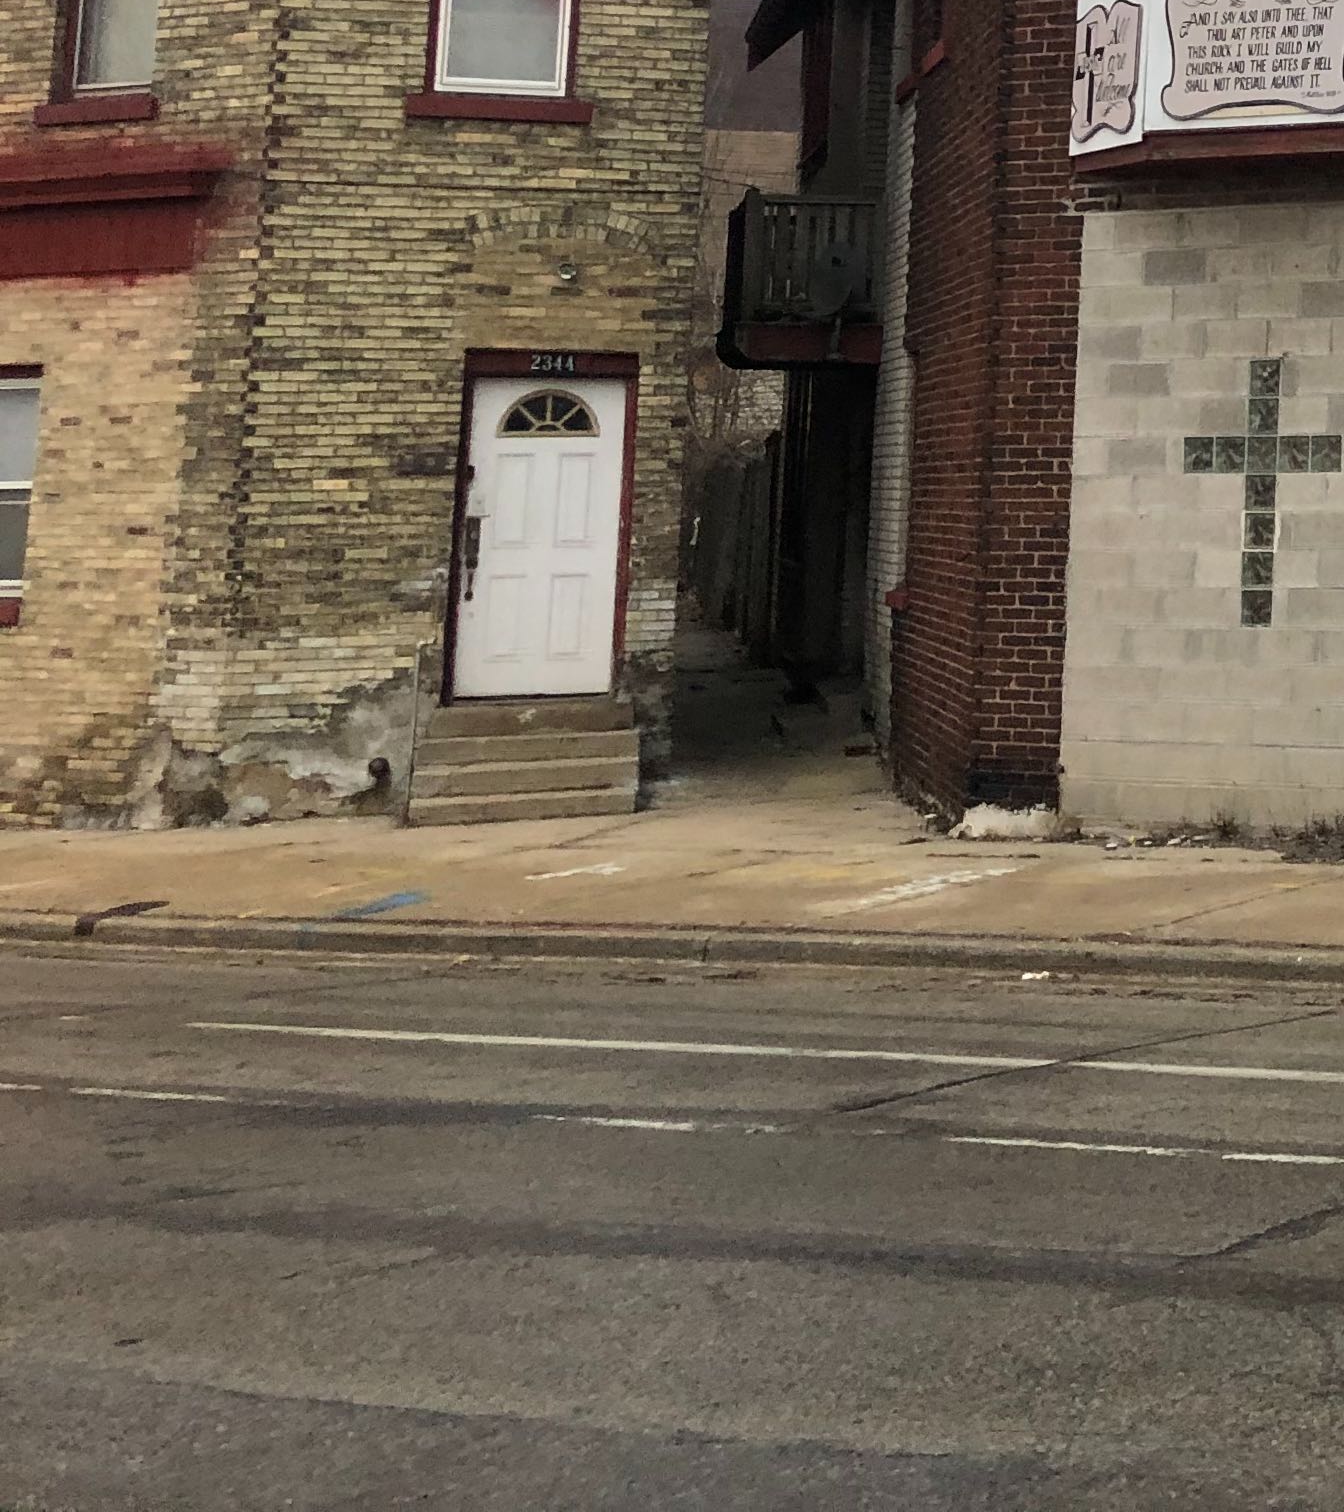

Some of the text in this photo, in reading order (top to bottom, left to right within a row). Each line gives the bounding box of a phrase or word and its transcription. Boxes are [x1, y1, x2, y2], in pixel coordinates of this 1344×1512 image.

[1213, 11, 1218, 26] I
[1220, 11, 1237, 25] SAY
[1238, 9, 1258, 24] ALSO
[1261, 8, 1281, 23] UNTO
[1312, 6, 1334, 20] THAT
[1207, 23, 1325, 42] THOU ART PETER AND UPON
[1187, 40, 1323, 59] THIS ROCK I WILL BUILD MY
[1226, 60, 1245, 74] AND
[1250, 59, 1266, 73] THE
[1271, 58, 1298, 72] GATES
[1301, 57, 1311, 70] OF
[1314, 56, 1332, 70] HELL
[1185, 78, 1208, 93] SHALL
[1214, 77, 1231, 91] NOT
[1234, 76, 1266, 91] PREVAIL
[1271, 74, 1304, 89] AGAINST
[531, 354, 574, 372] 2344
